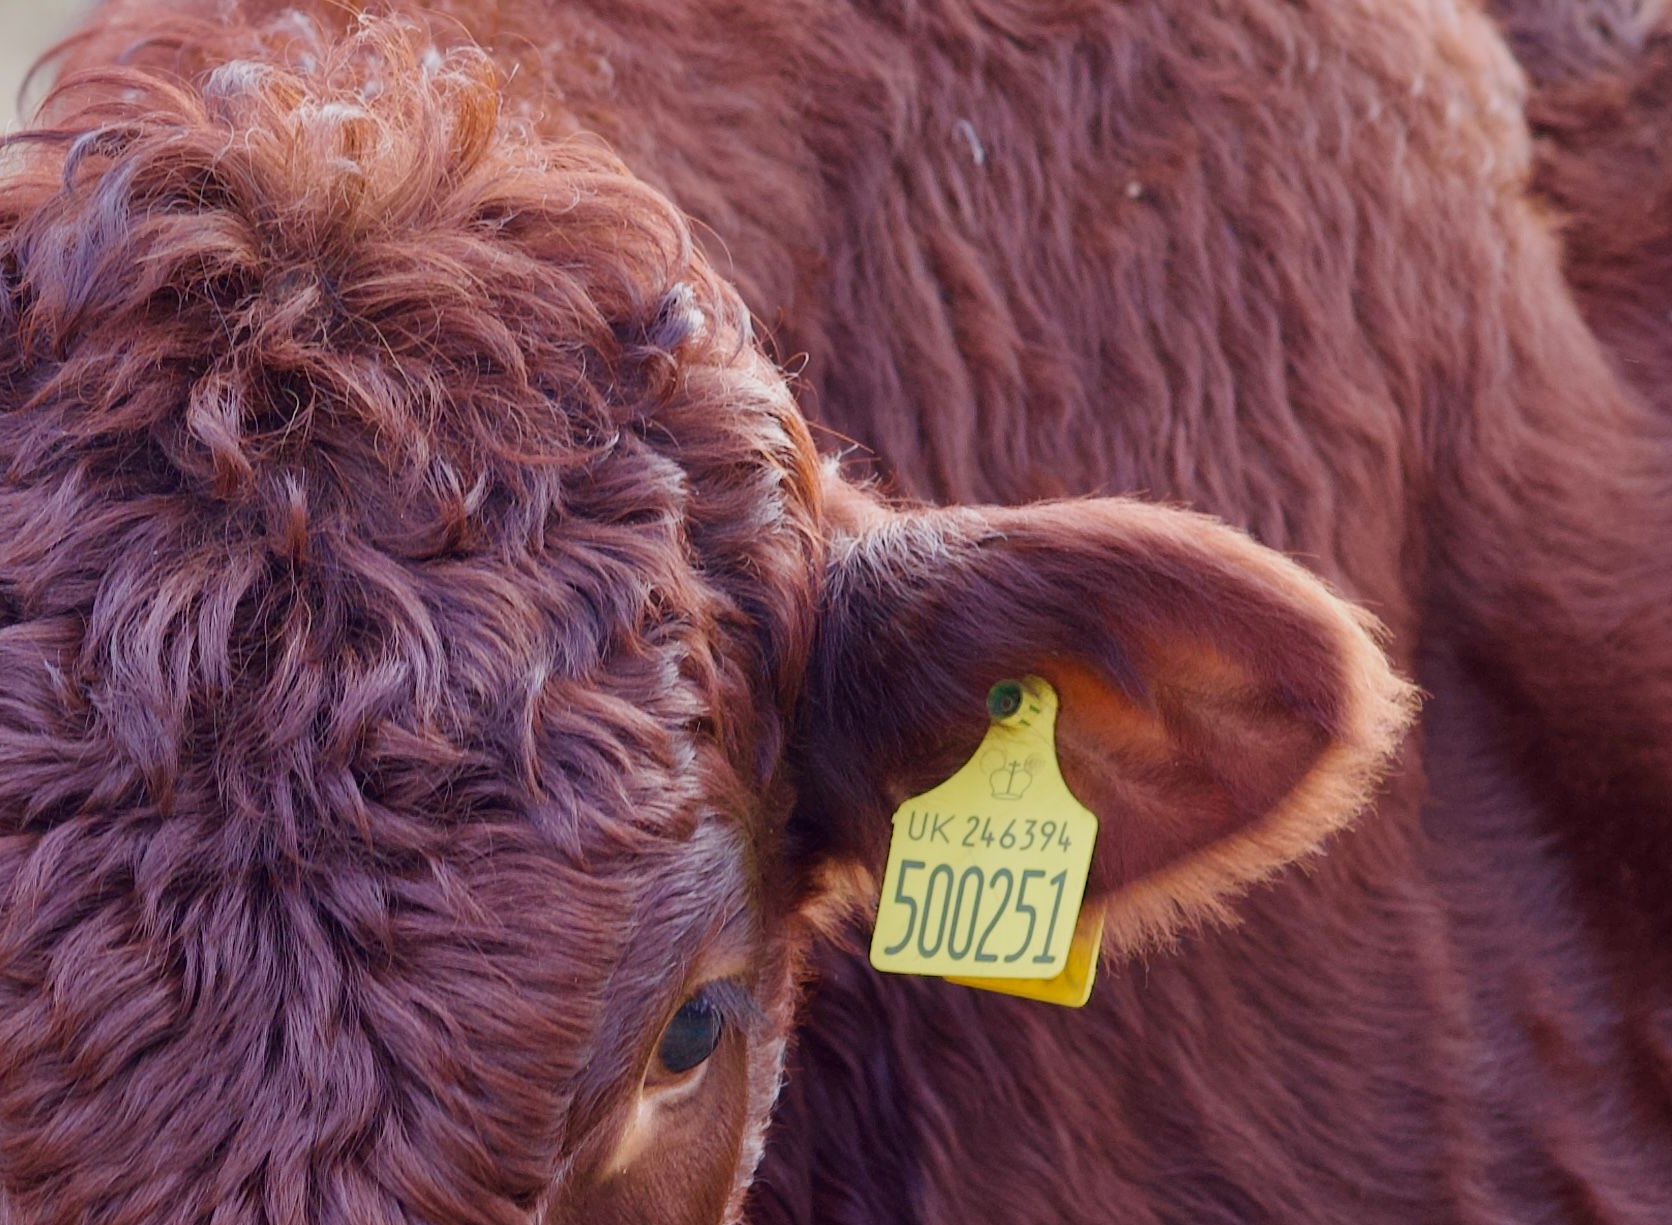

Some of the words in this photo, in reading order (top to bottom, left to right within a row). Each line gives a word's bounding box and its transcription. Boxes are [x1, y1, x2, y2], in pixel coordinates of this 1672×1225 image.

[908, 811, 956, 844] UK
[961, 816, 1072, 852] 246394
[884, 859, 1068, 964] 500251
